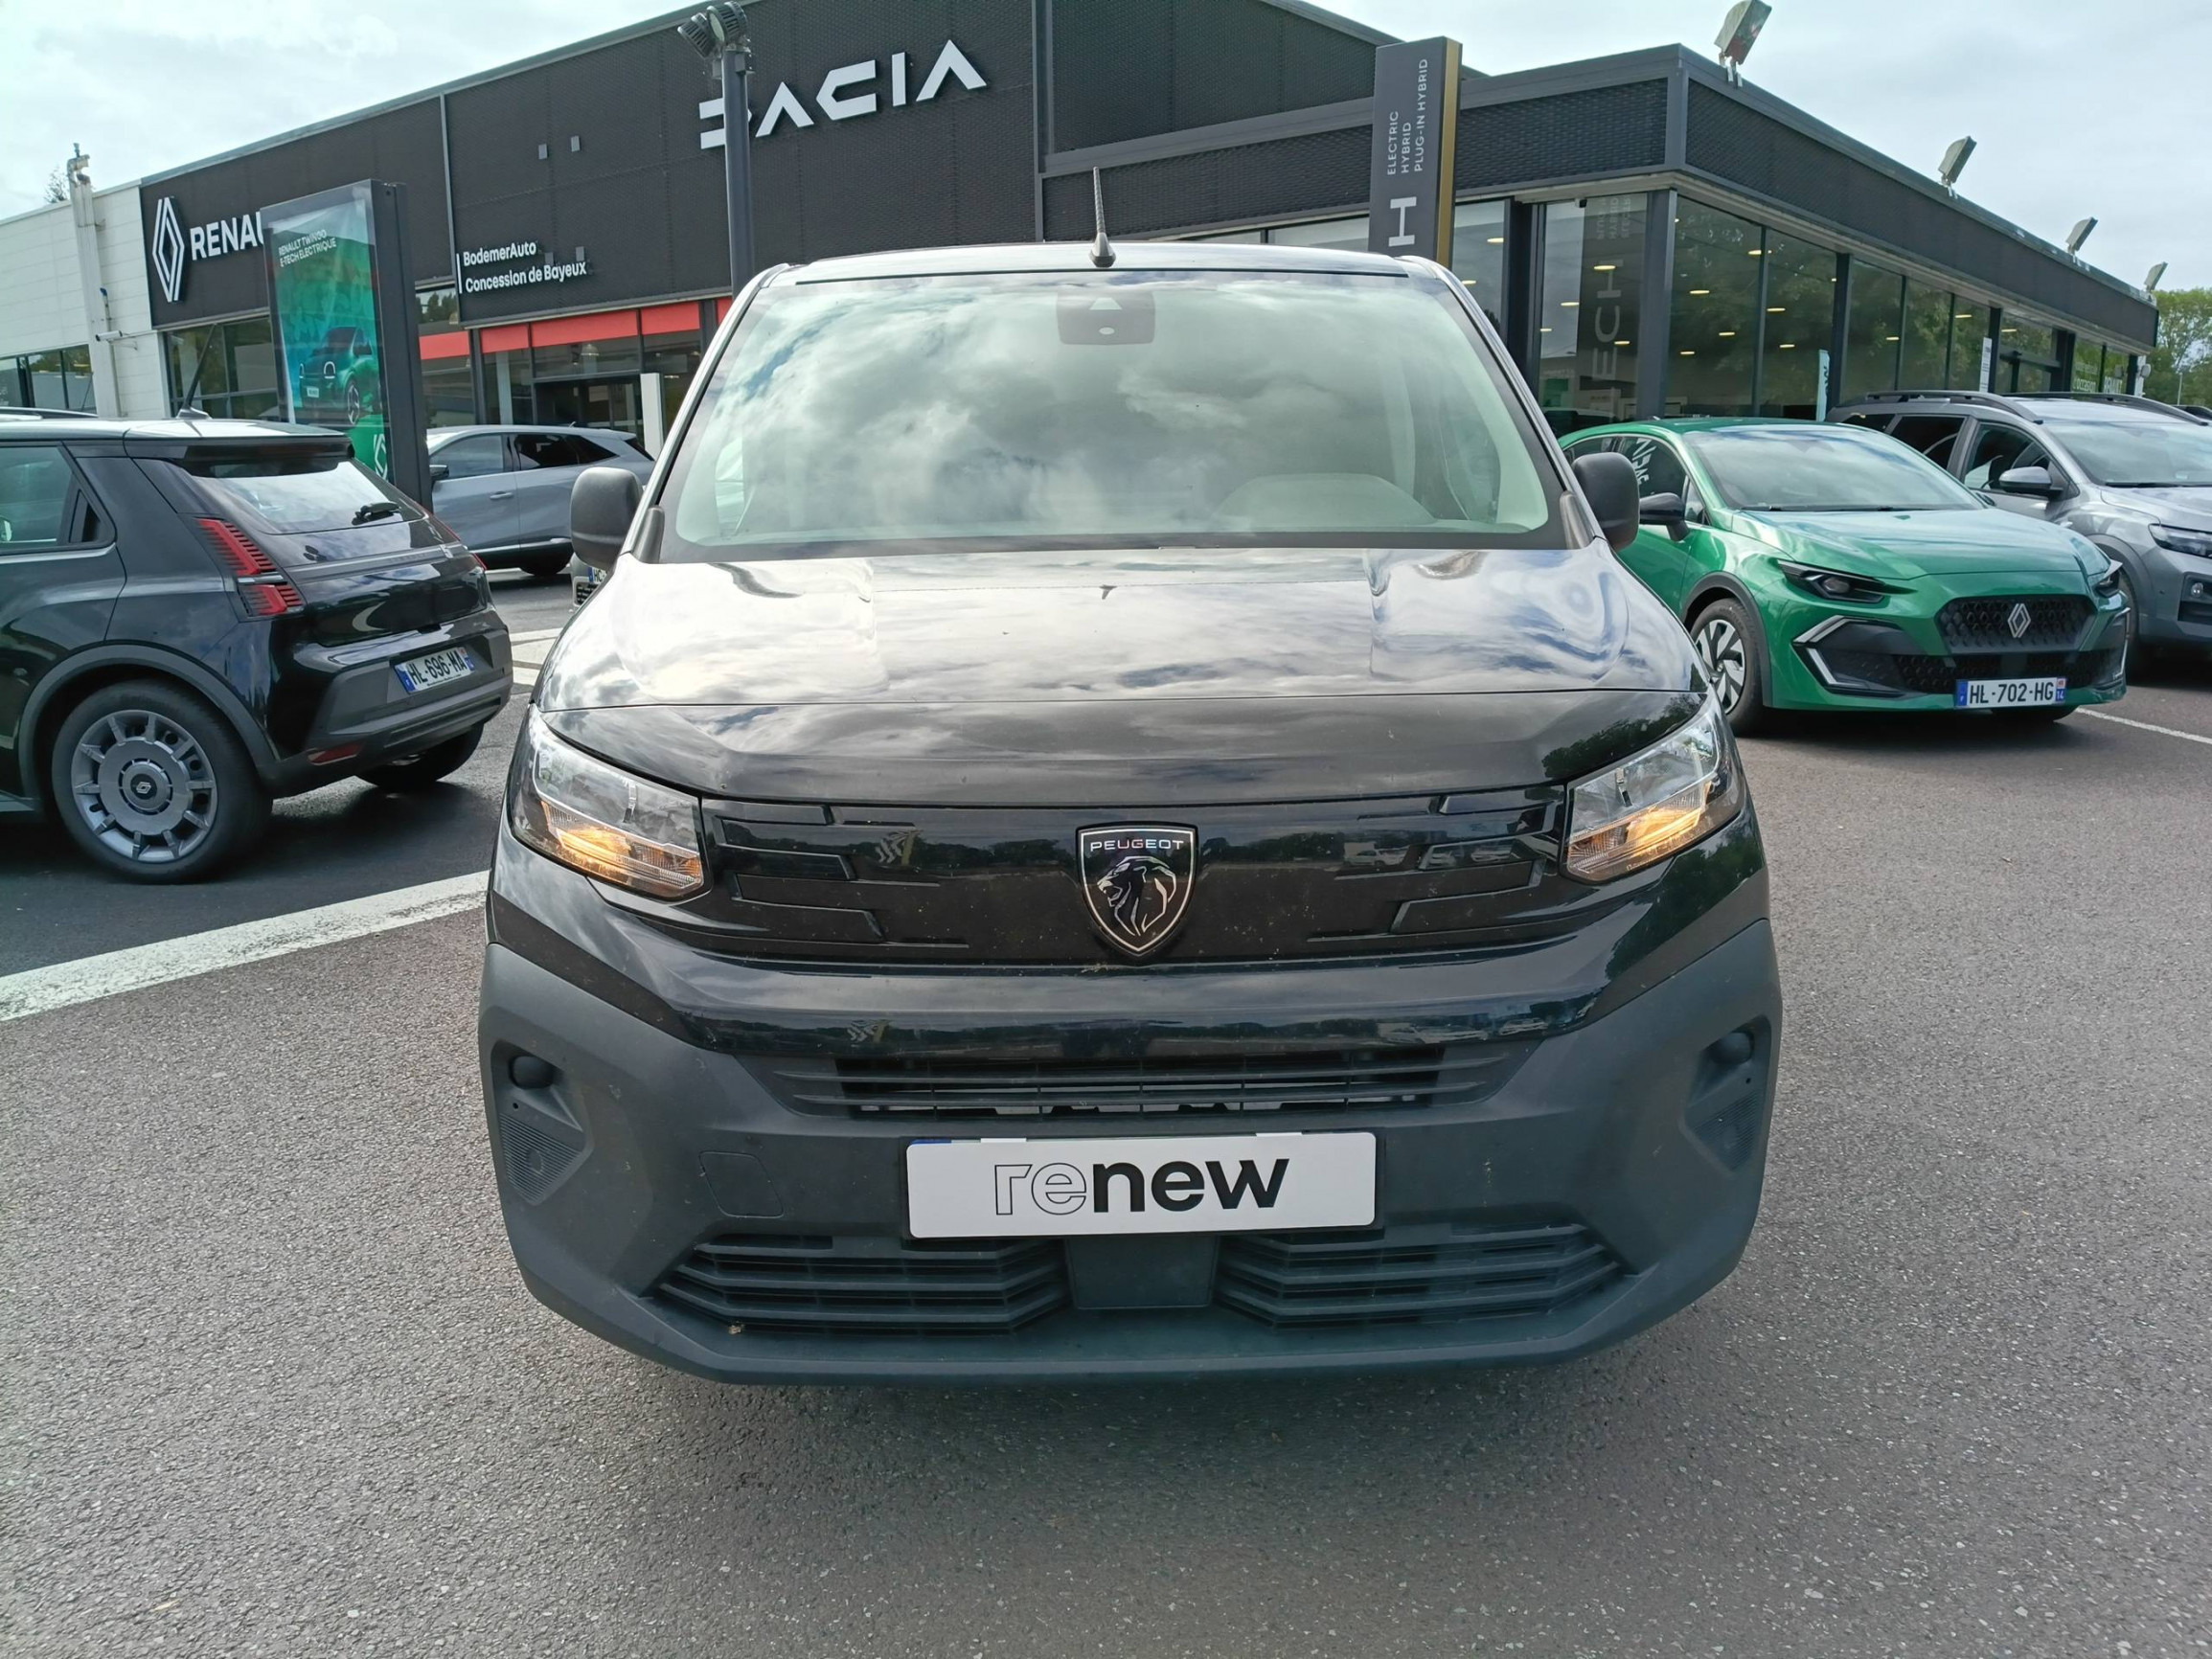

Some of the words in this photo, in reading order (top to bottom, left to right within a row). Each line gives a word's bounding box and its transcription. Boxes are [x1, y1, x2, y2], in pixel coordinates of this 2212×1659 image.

[1417, 58, 1428, 111] HYBRID
[1387, 111, 1400, 175] ELECTRIC
[1401, 122, 1412, 173] HYBRID
[1414, 115, 1425, 172] PLUG-IN
[463, 241, 537, 267] BodemerAuto
[465, 269, 528, 293] Concession
[528, 265, 542, 283] de
[543, 261, 587, 283] Bayeux
[1969, 681, 2055, 704] HL-702-HG
[1090, 839, 1185, 852] PEUGEOT
[994, 1158, 1290, 1216] renew
